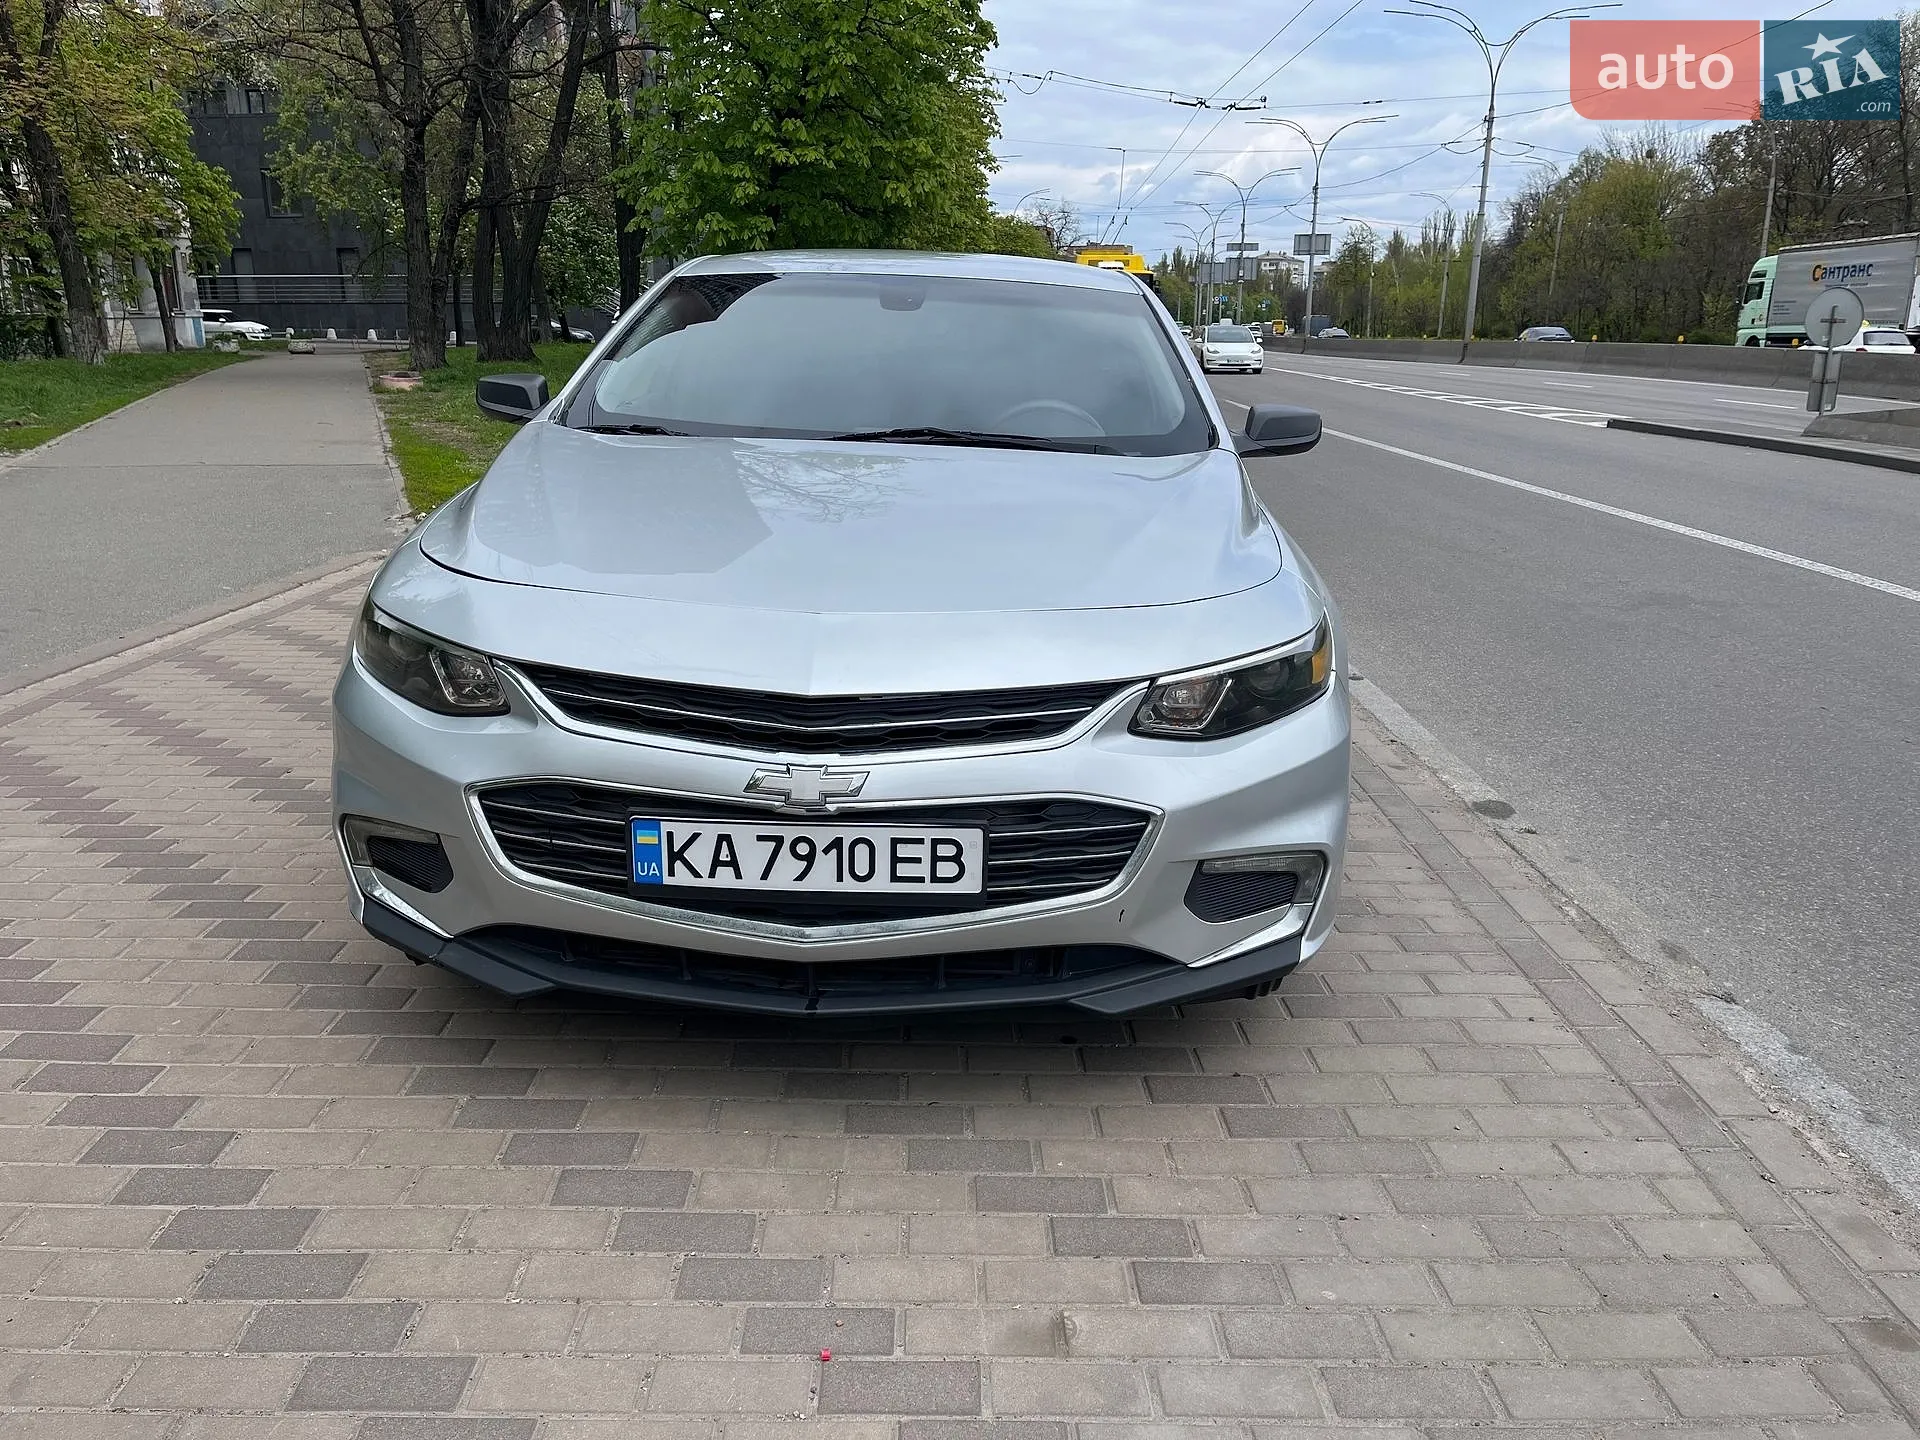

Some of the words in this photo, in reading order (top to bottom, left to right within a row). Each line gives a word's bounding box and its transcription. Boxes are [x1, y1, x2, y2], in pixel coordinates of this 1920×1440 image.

[1812, 263, 1874, 282] Сантранс
[666, 830, 743, 880] KA
[756, 834, 876, 883] 7910
[889, 836, 967, 884] EB
[638, 861, 660, 876] UA
